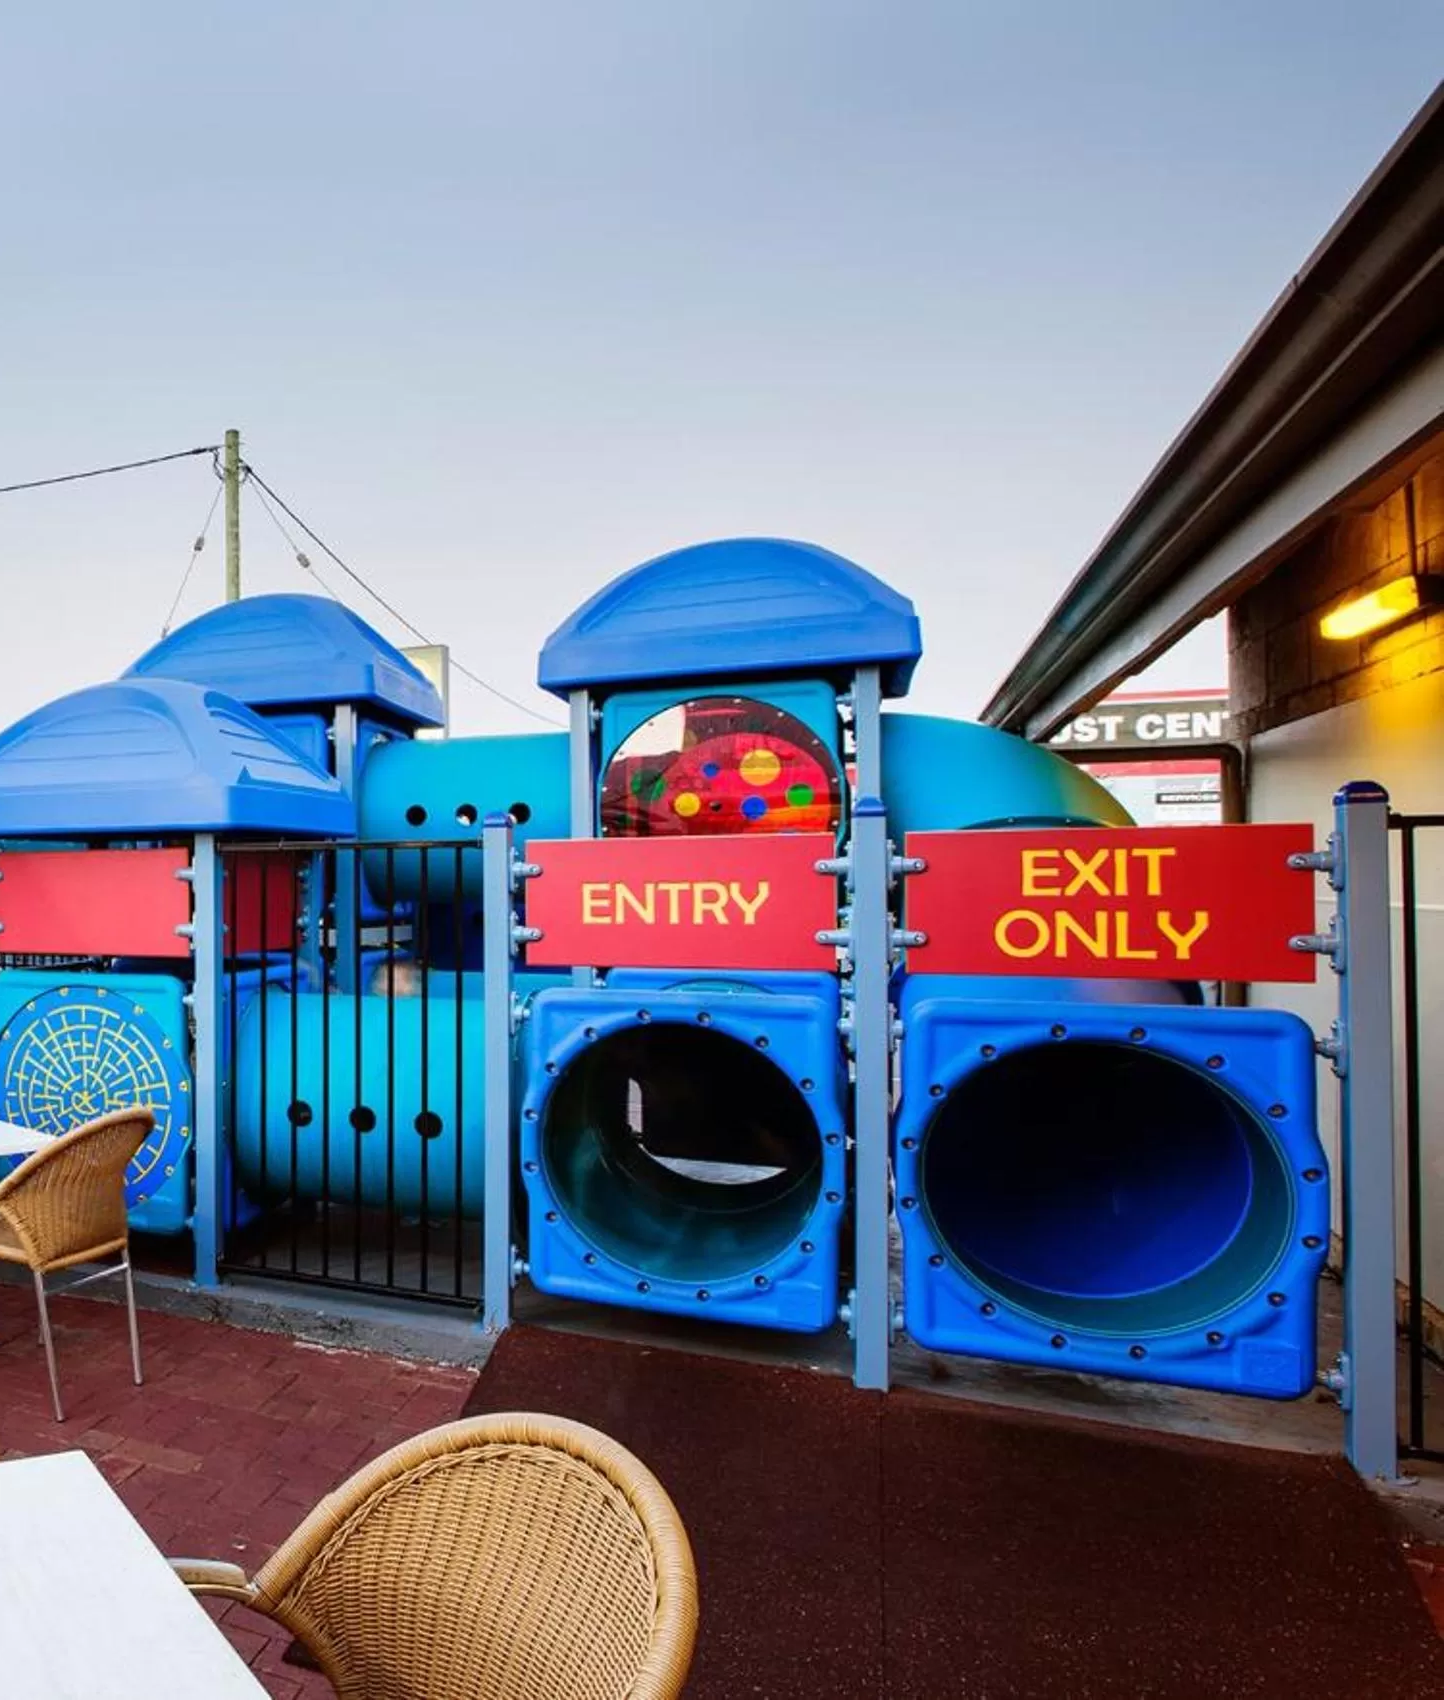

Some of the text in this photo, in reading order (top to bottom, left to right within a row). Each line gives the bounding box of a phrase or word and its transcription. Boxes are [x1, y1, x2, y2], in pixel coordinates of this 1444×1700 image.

[1135, 711, 1229, 740] CEN
[1022, 848, 1176, 896] EXIT
[581, 881, 769, 925] ENTRY
[994, 908, 1210, 960] ONLY
